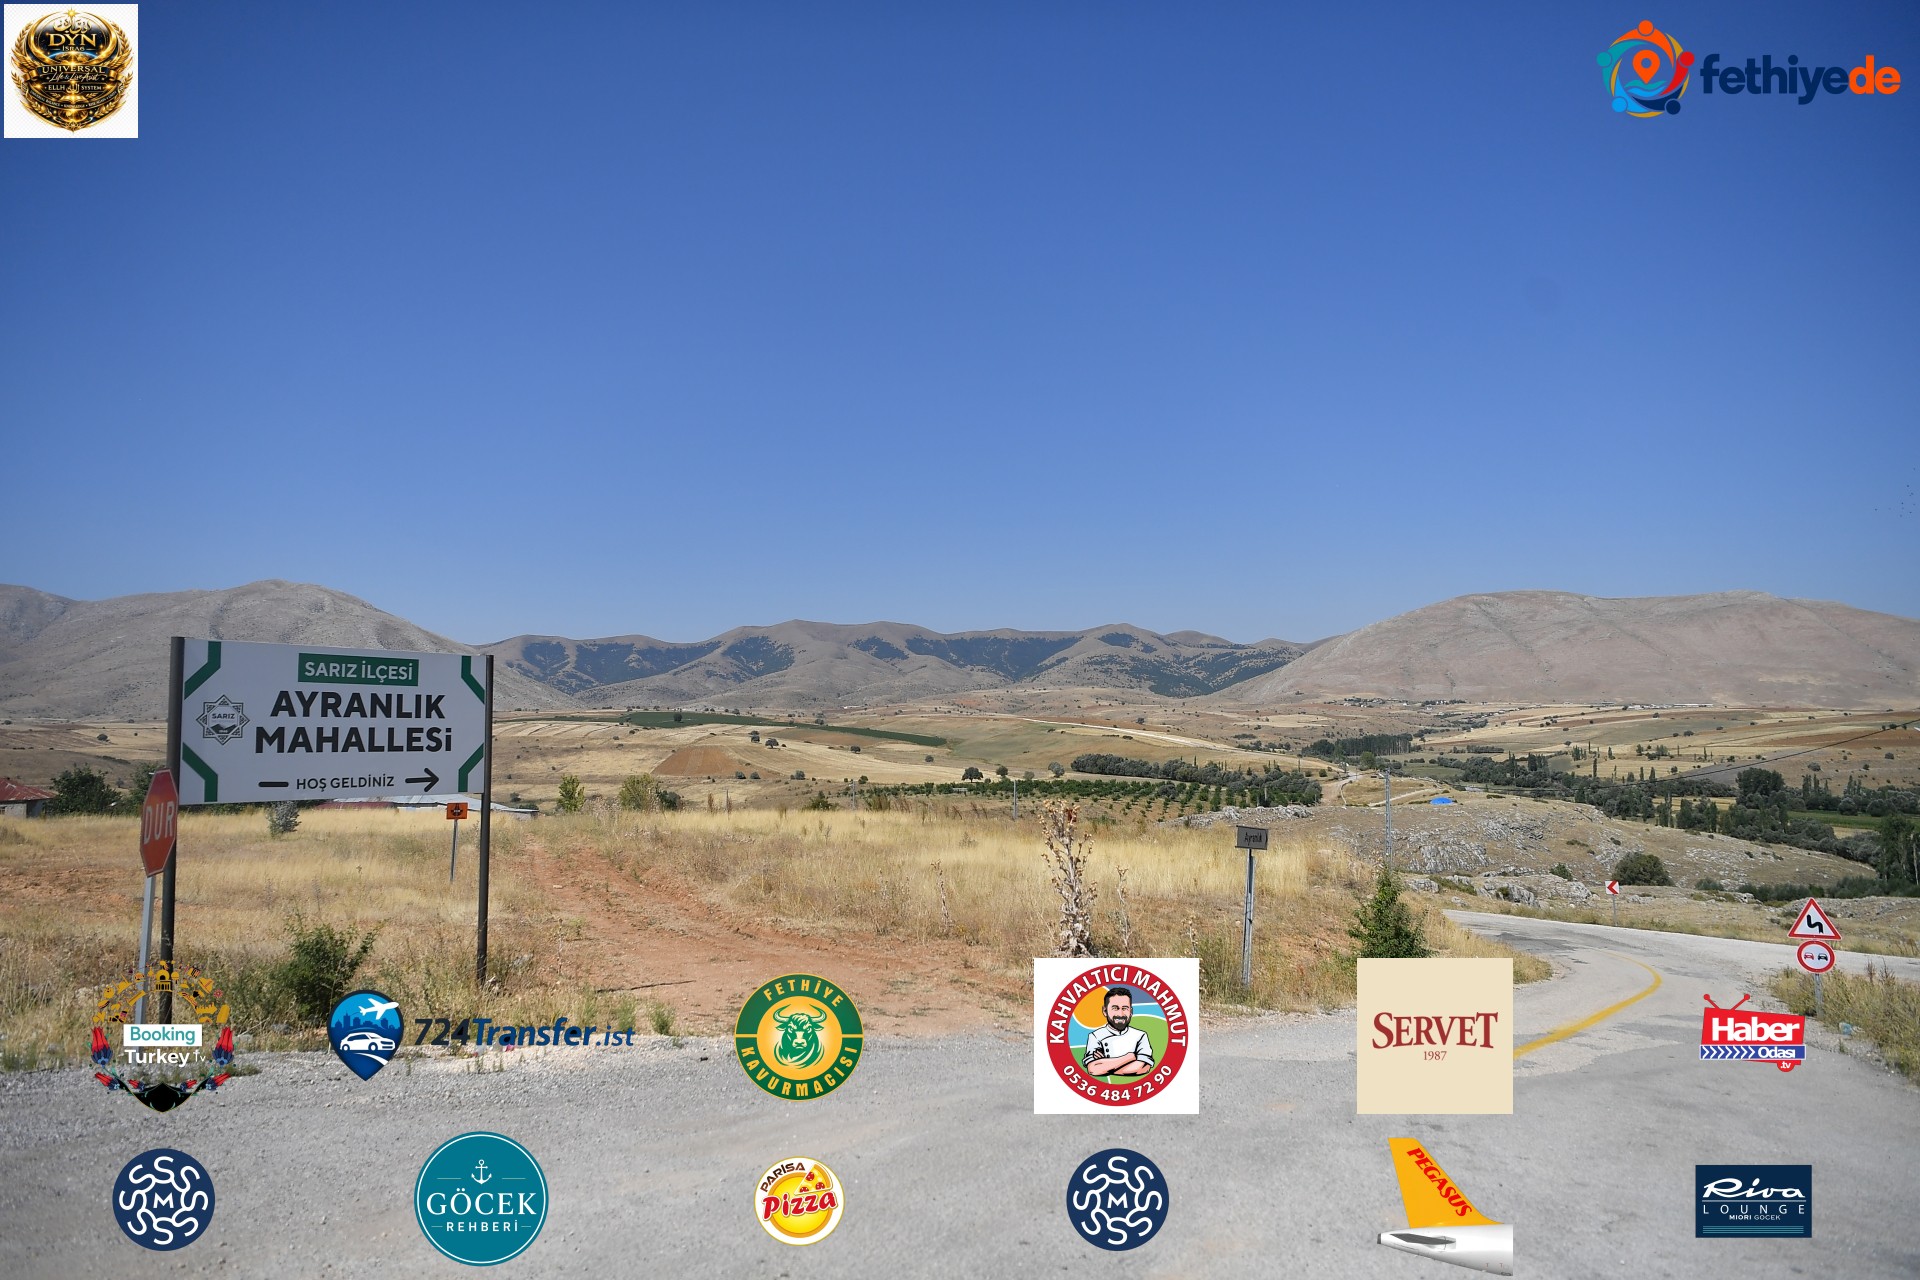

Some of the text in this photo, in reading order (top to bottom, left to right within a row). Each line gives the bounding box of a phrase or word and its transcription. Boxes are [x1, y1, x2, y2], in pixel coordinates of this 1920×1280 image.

[304, 660, 413, 683] SARIZ İLÇESİ
[270, 690, 446, 719] AYRANLIK
[296, 773, 395, 792] HOŞ GELDİNİZ
[143, 800, 175, 845] DUR
